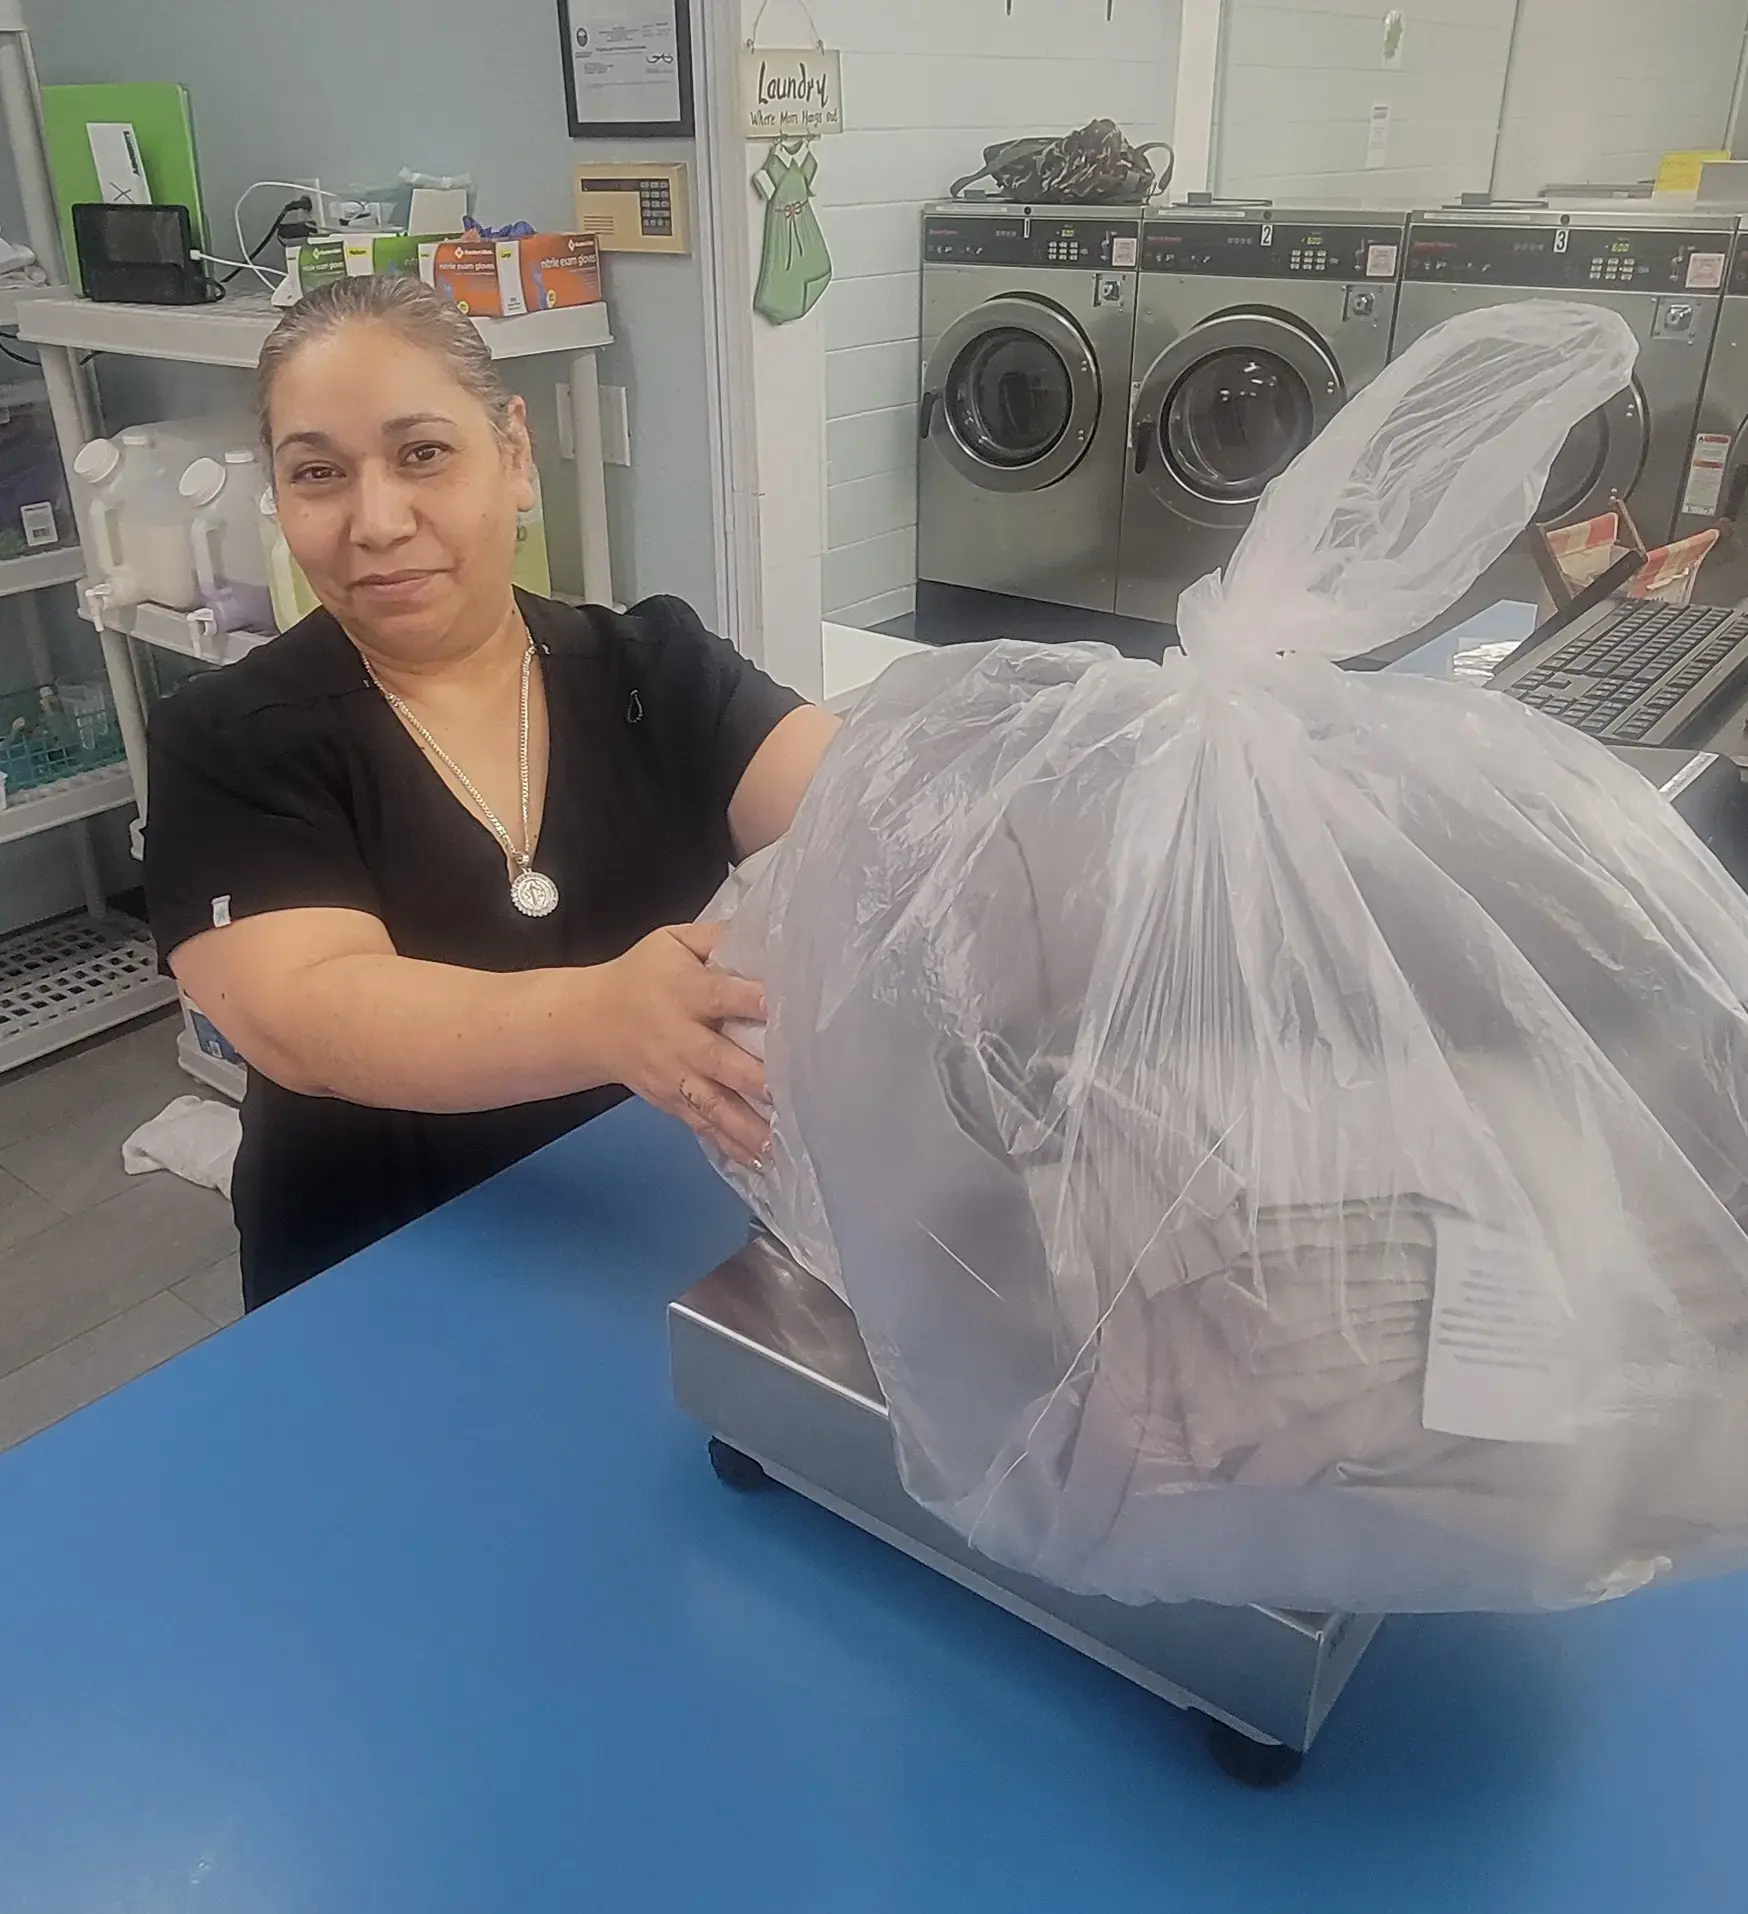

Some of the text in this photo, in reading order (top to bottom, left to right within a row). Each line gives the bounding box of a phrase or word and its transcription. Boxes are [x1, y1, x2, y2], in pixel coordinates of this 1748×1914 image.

[758, 60, 828, 108] Laundry
[750, 107, 838, 128] Where Mom Hangs out
[1263, 225, 1271, 244] 2
[1556, 230, 1566, 250] 3
[457, 262, 474, 270] exam
[475, 262, 495, 272] gloves
[541, 253, 597, 268] nitrile exam gloves
